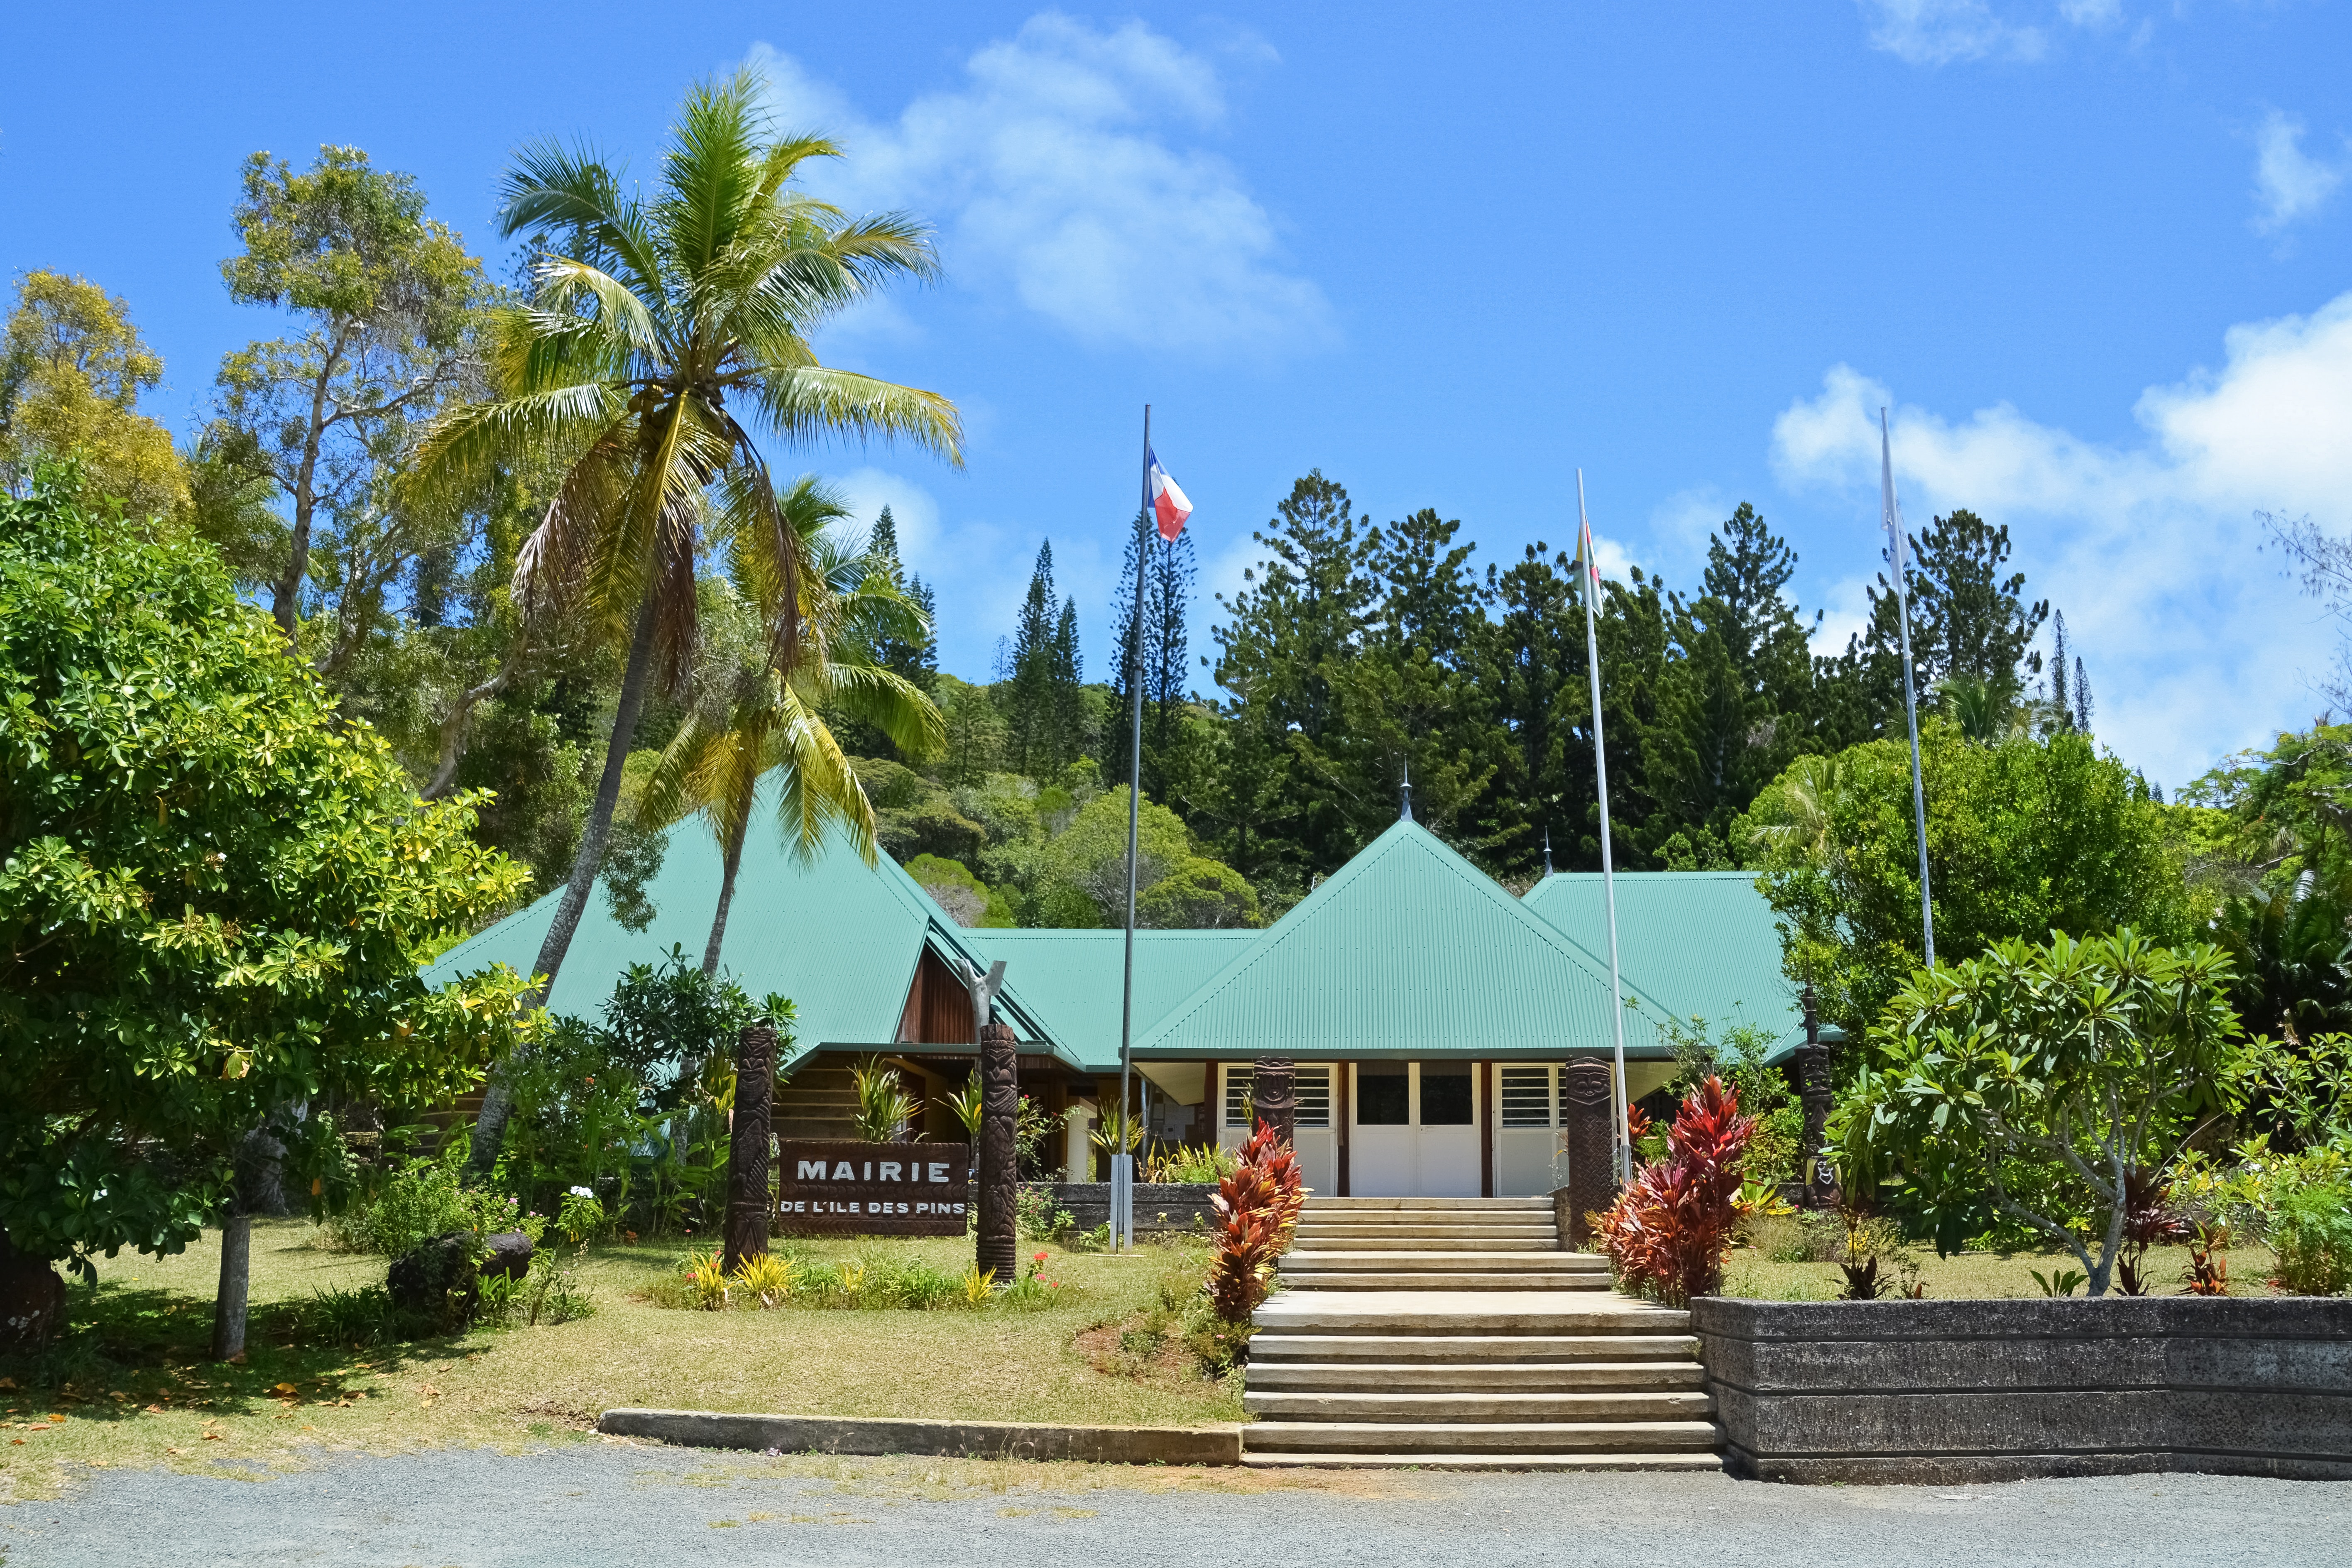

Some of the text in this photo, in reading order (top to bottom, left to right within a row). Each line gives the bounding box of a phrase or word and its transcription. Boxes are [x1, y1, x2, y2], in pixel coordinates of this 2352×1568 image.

[798, 1161, 950, 1182] MAIRIE
[781, 1201, 965, 1214] DE L'ILE DES PINS
